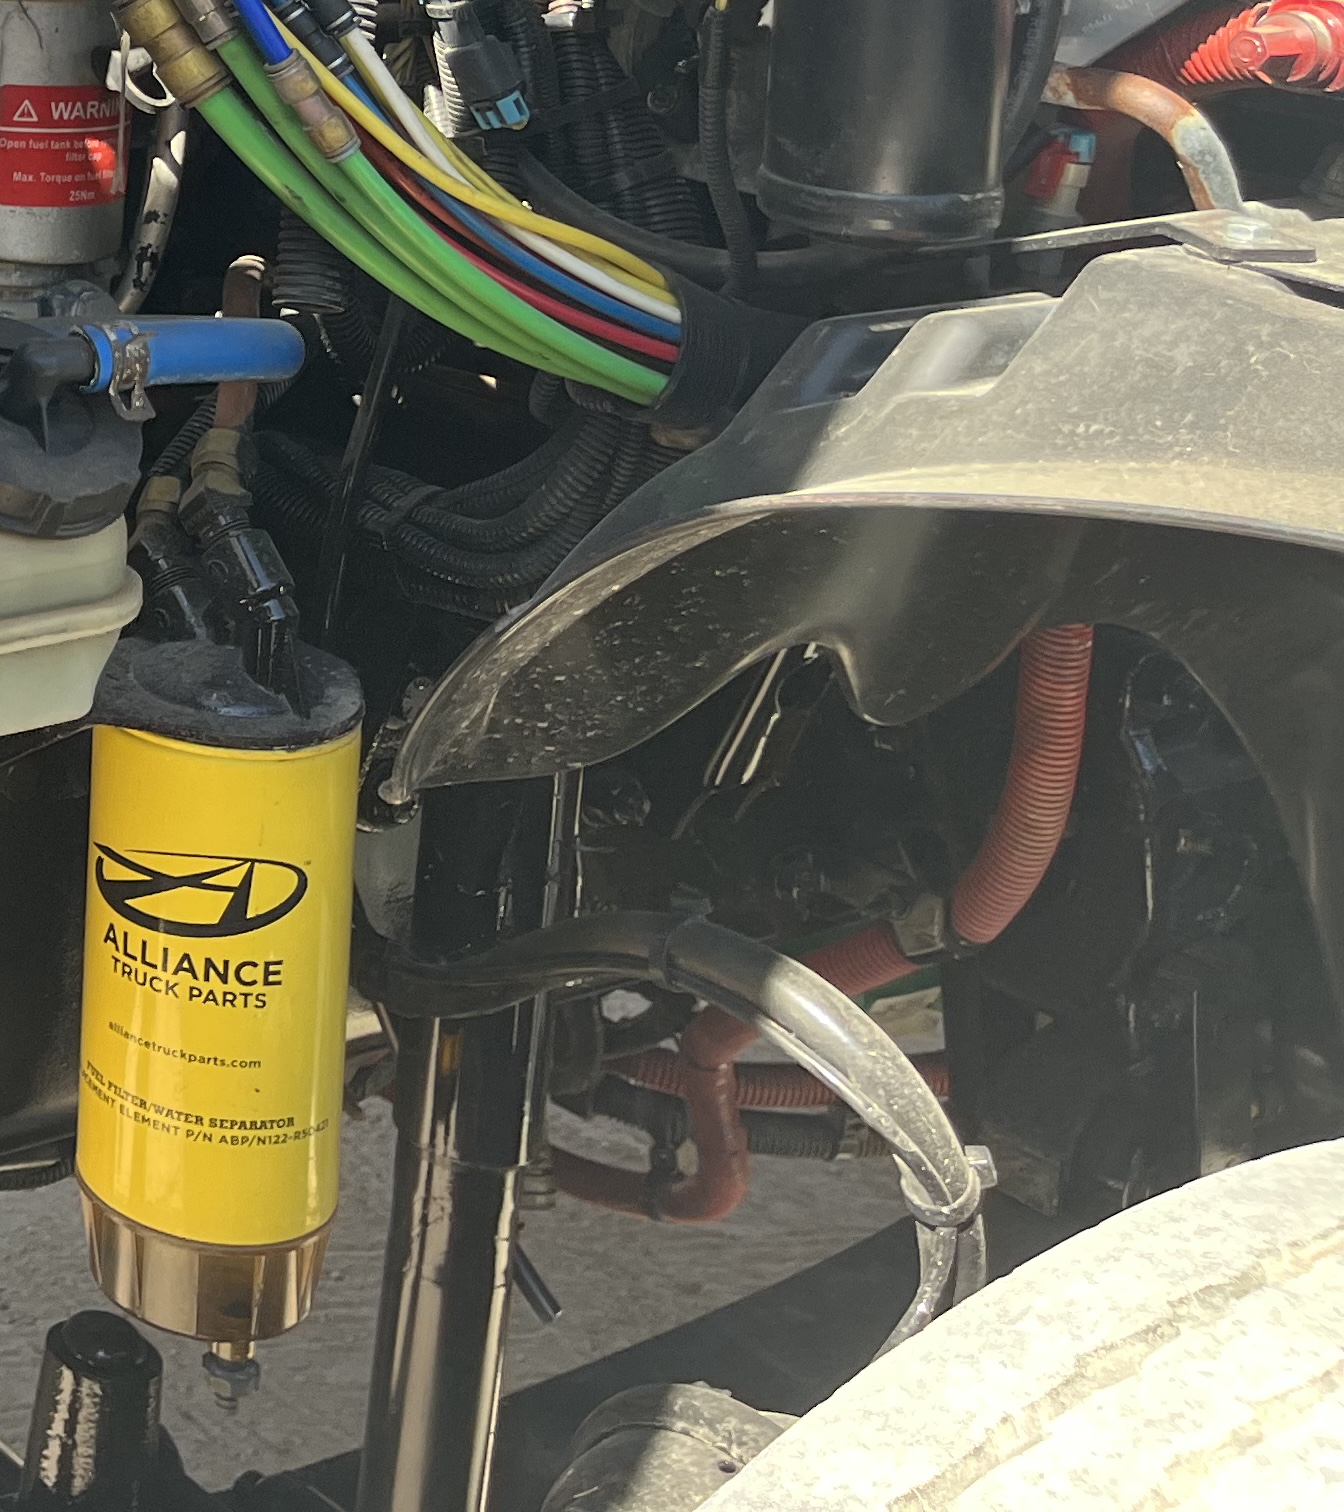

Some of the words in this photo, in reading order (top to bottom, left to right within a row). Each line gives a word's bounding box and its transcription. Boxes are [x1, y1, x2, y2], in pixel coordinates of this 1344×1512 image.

[28, 138, 48, 149] fuel
[50, 139, 70, 150] tank
[39, 171, 72, 185] Torque
[103, 922, 284, 988] ALLIANCE
[111, 955, 180, 999] TRUCK
[189, 986, 268, 1010] PARTS
[108, 1021, 262, 1070] alliancetruckparts.com
[87, 1059, 106, 1086] FUEL
[107, 1079, 205, 1127] FILTER/WATER
[208, 1116, 296, 1131] SEPARATOR
[119, 1102, 180, 1137] ELEMENT
[185, 1128, 213, 1143] P/N
